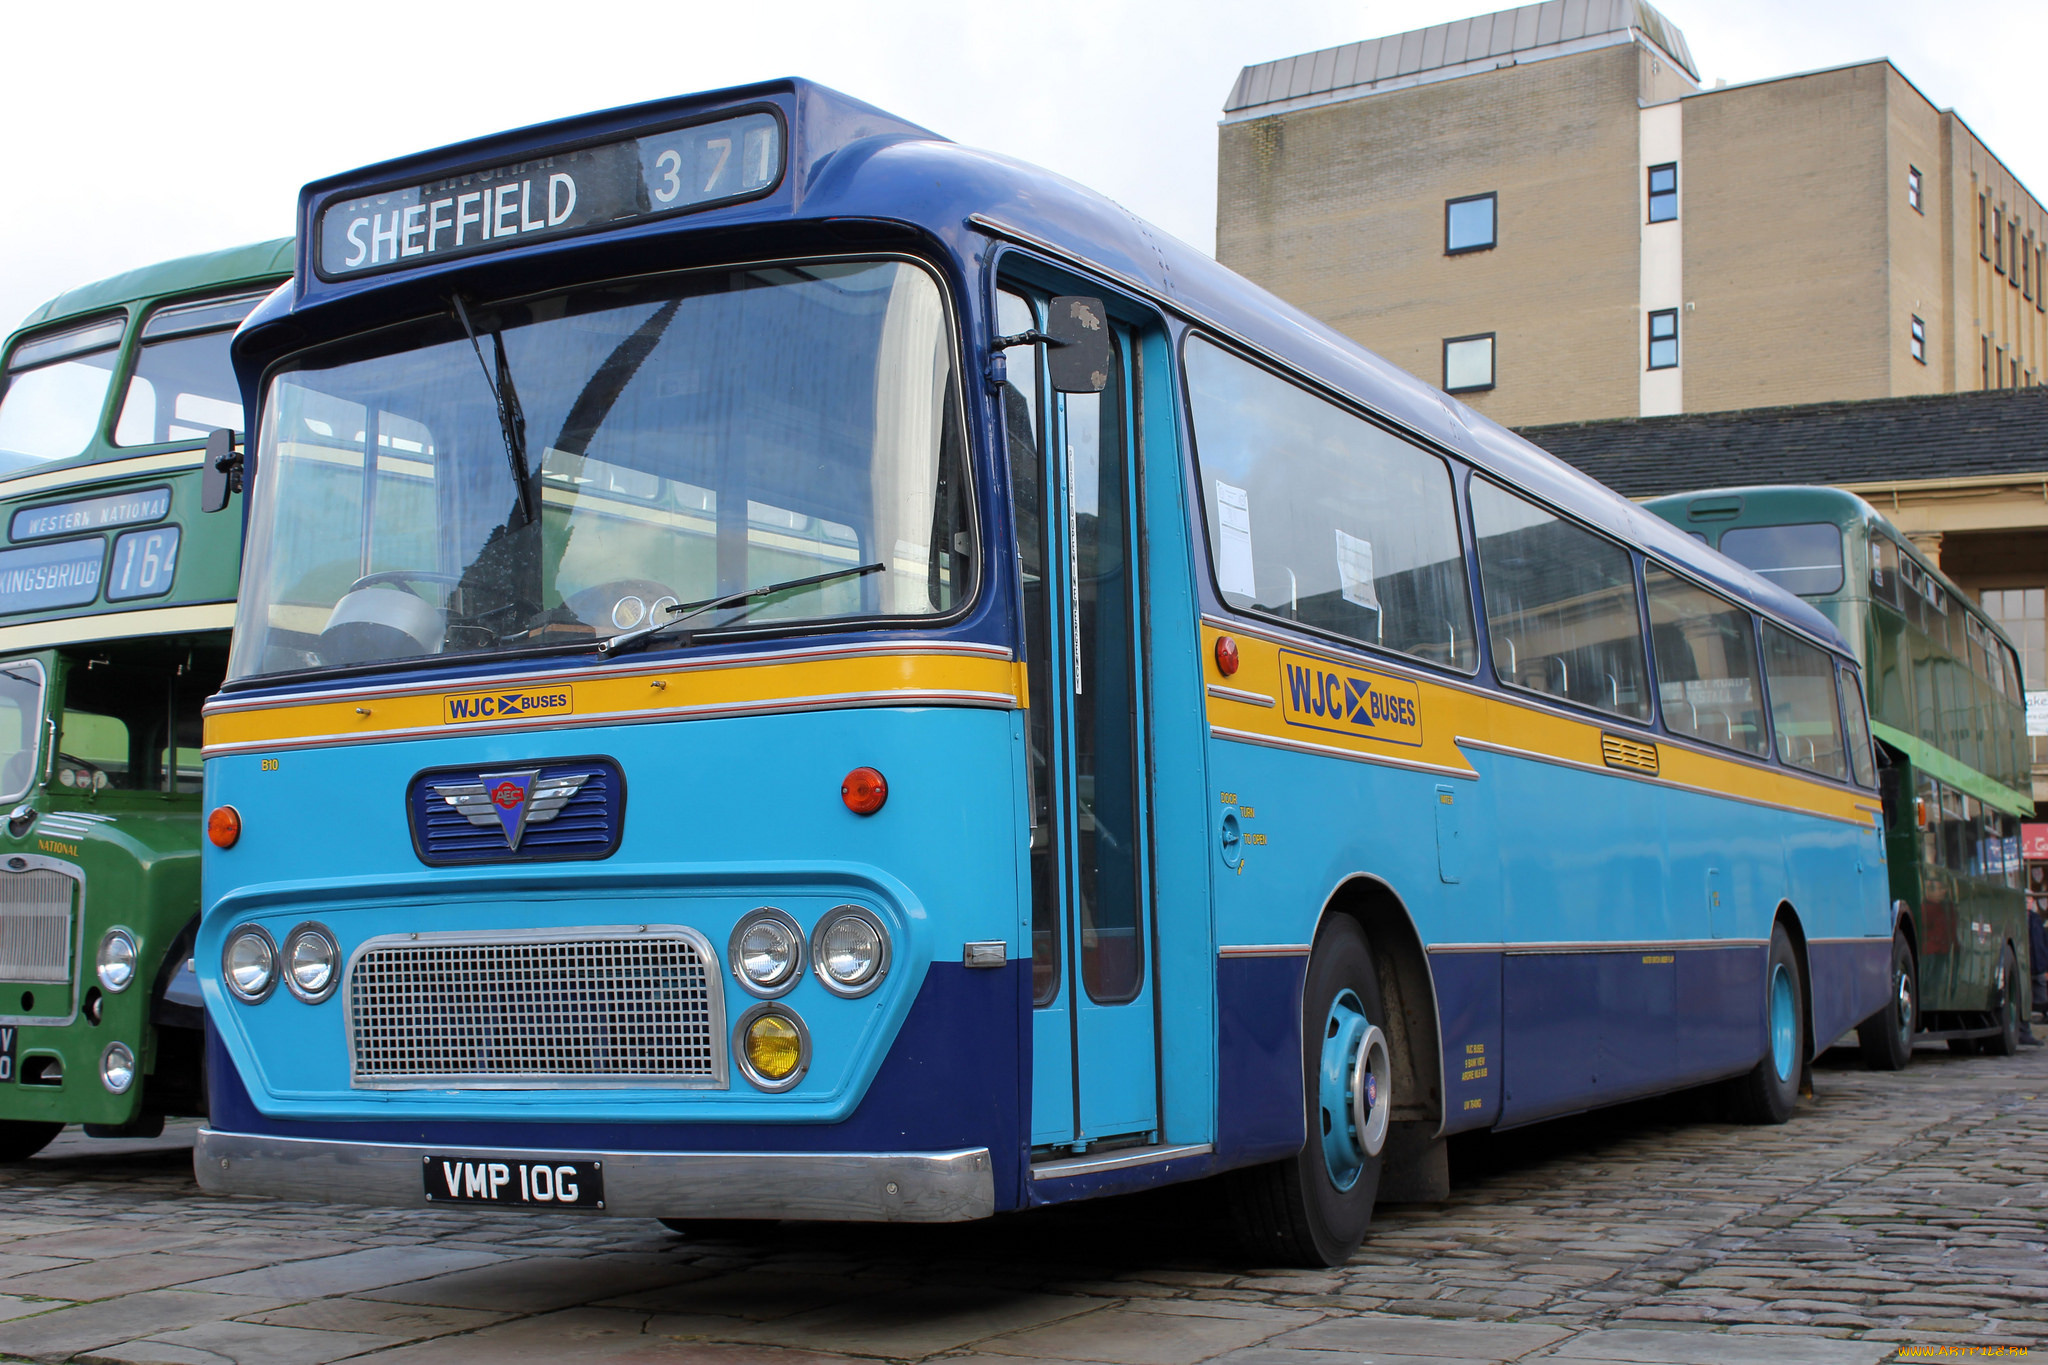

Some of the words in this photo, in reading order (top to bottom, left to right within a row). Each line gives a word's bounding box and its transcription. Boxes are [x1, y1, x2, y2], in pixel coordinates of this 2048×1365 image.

[345, 173, 577, 267] SHEFFIELD
[29, 511, 91, 535] WESTERN
[100, 498, 167, 524] NATIONAL
[1287, 663, 1342, 720] WJC
[1370, 690, 1416, 727] BUSES
[450, 697, 495, 719] WJC
[521, 694, 567, 709] BUSES
[261, 758, 280, 771] B10
[495, 790, 522, 801] AEC
[1220, 791, 1238, 805] DOOR
[1240, 806, 1255, 818] TURN
[38, 839, 79, 857] NATIONAL
[1243, 832, 1252, 845] TO
[1252, 833, 1267, 846] OPEN
[443, 1161, 510, 1199] VMP
[519, 1164, 579, 1202] 10G
